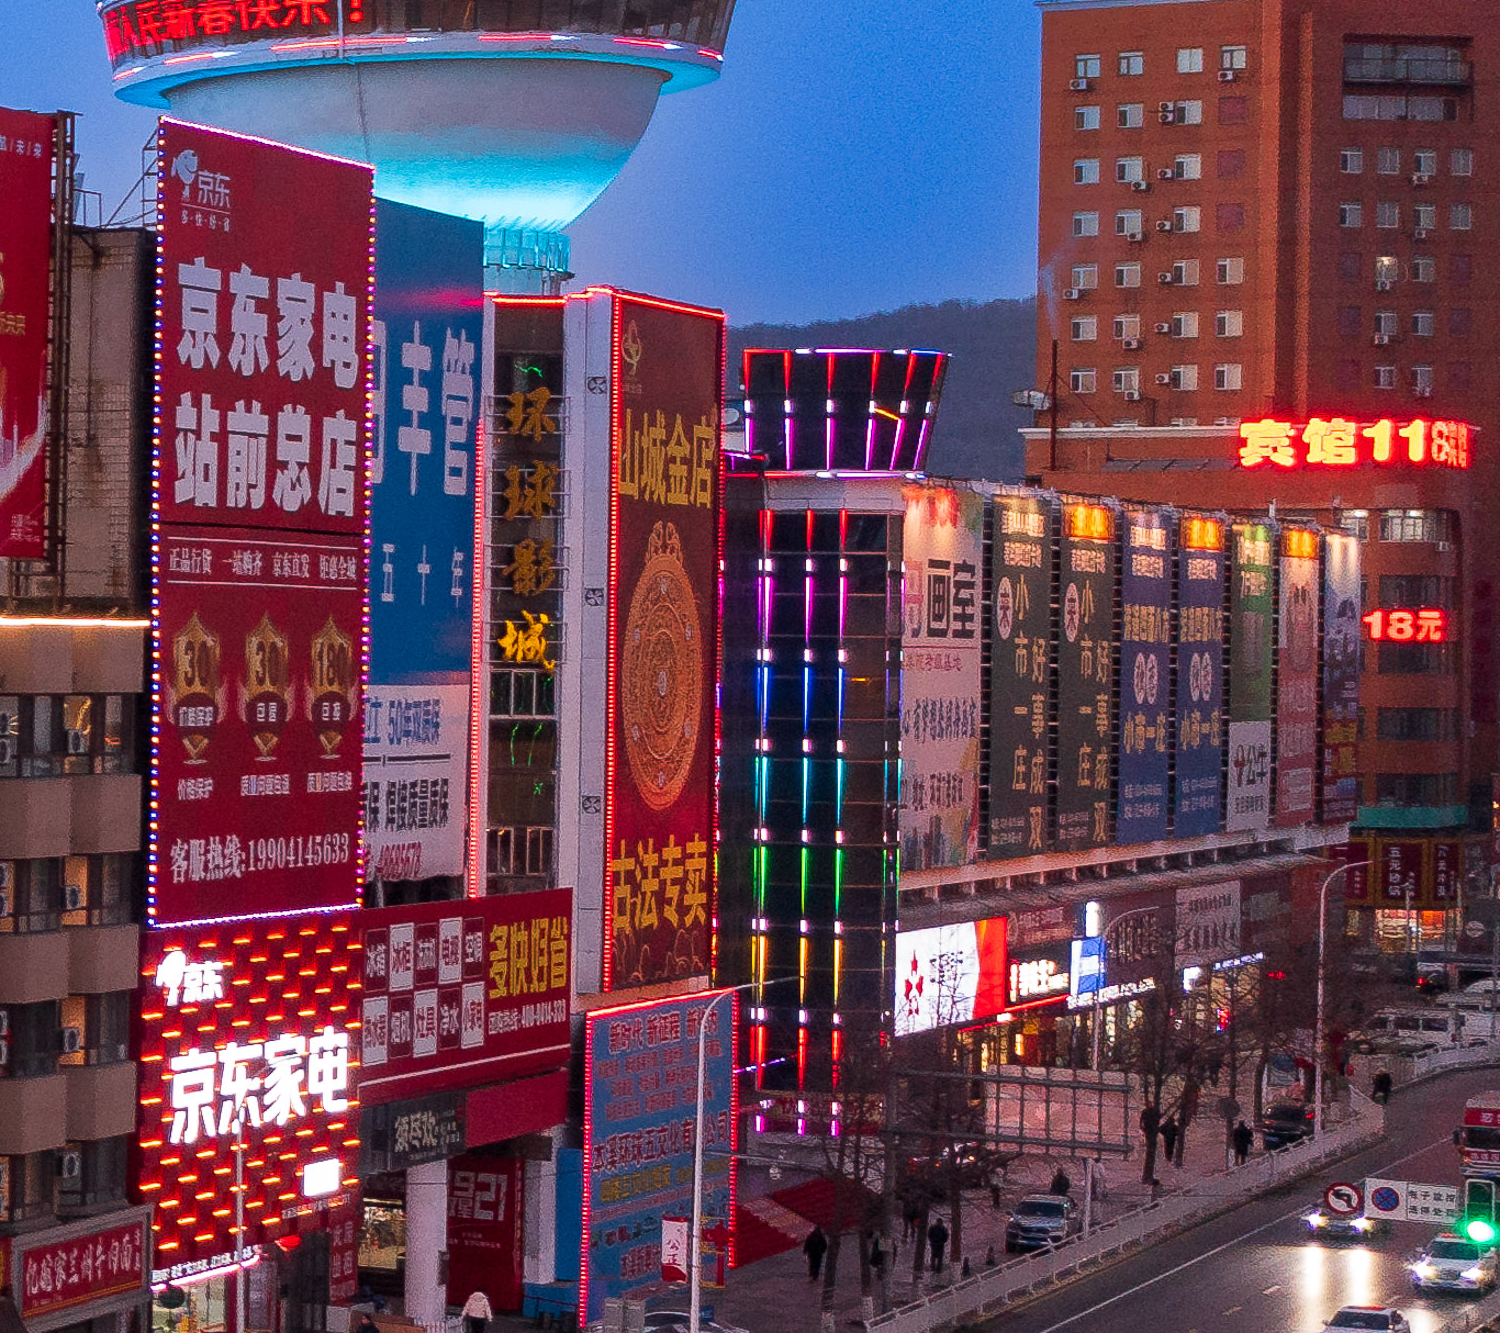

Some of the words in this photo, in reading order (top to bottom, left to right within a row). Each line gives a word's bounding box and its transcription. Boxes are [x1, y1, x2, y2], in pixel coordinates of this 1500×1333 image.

[196, 169, 231, 209] 京东
[176, 257, 359, 389] 京东家电
[174, 392, 357, 519] 站前总店
[499, 386, 558, 669] 环球影城
[489, 915, 569, 1000] 多快好省
[168, 1024, 349, 1145] 京东家电
[592, 1109, 729, 1173] 本溪环球五交化有公司
